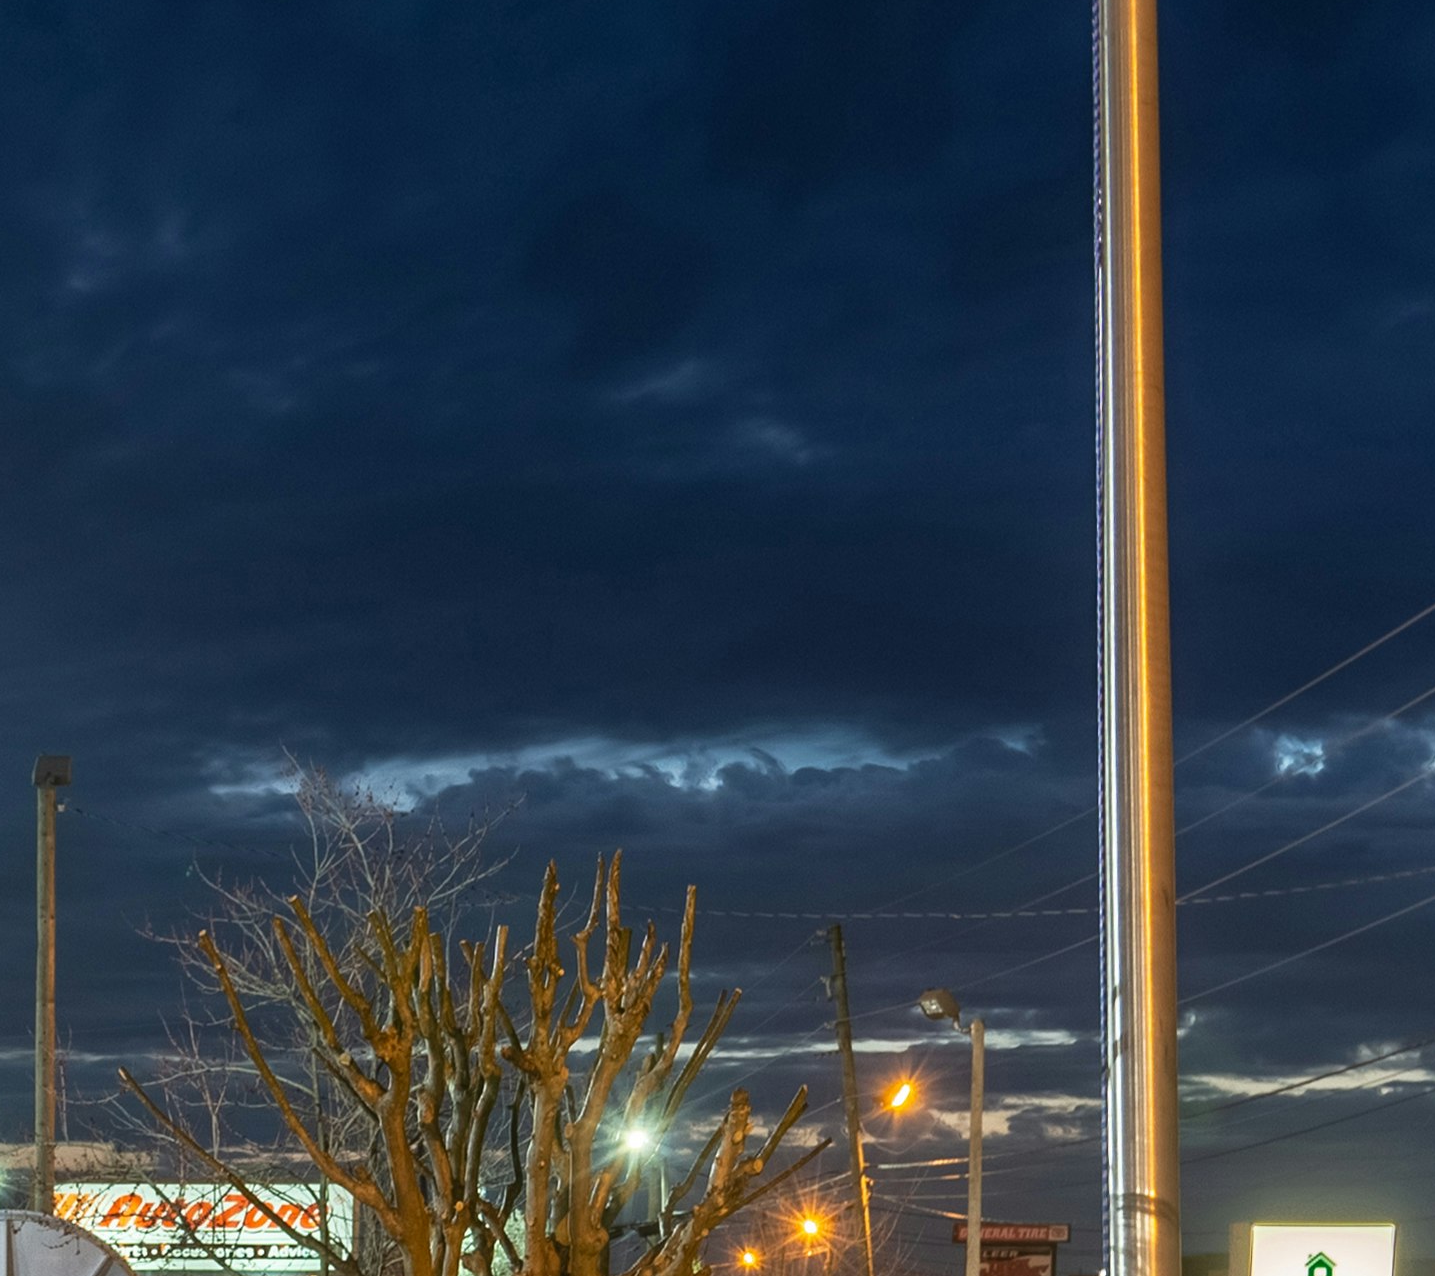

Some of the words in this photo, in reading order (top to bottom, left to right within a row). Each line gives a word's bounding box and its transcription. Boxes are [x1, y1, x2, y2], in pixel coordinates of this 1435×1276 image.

[99, 1193, 331, 1229] AutoZone
[959, 1226, 1016, 1239] GERAL
[1017, 1226, 1047, 1239] TIRE
